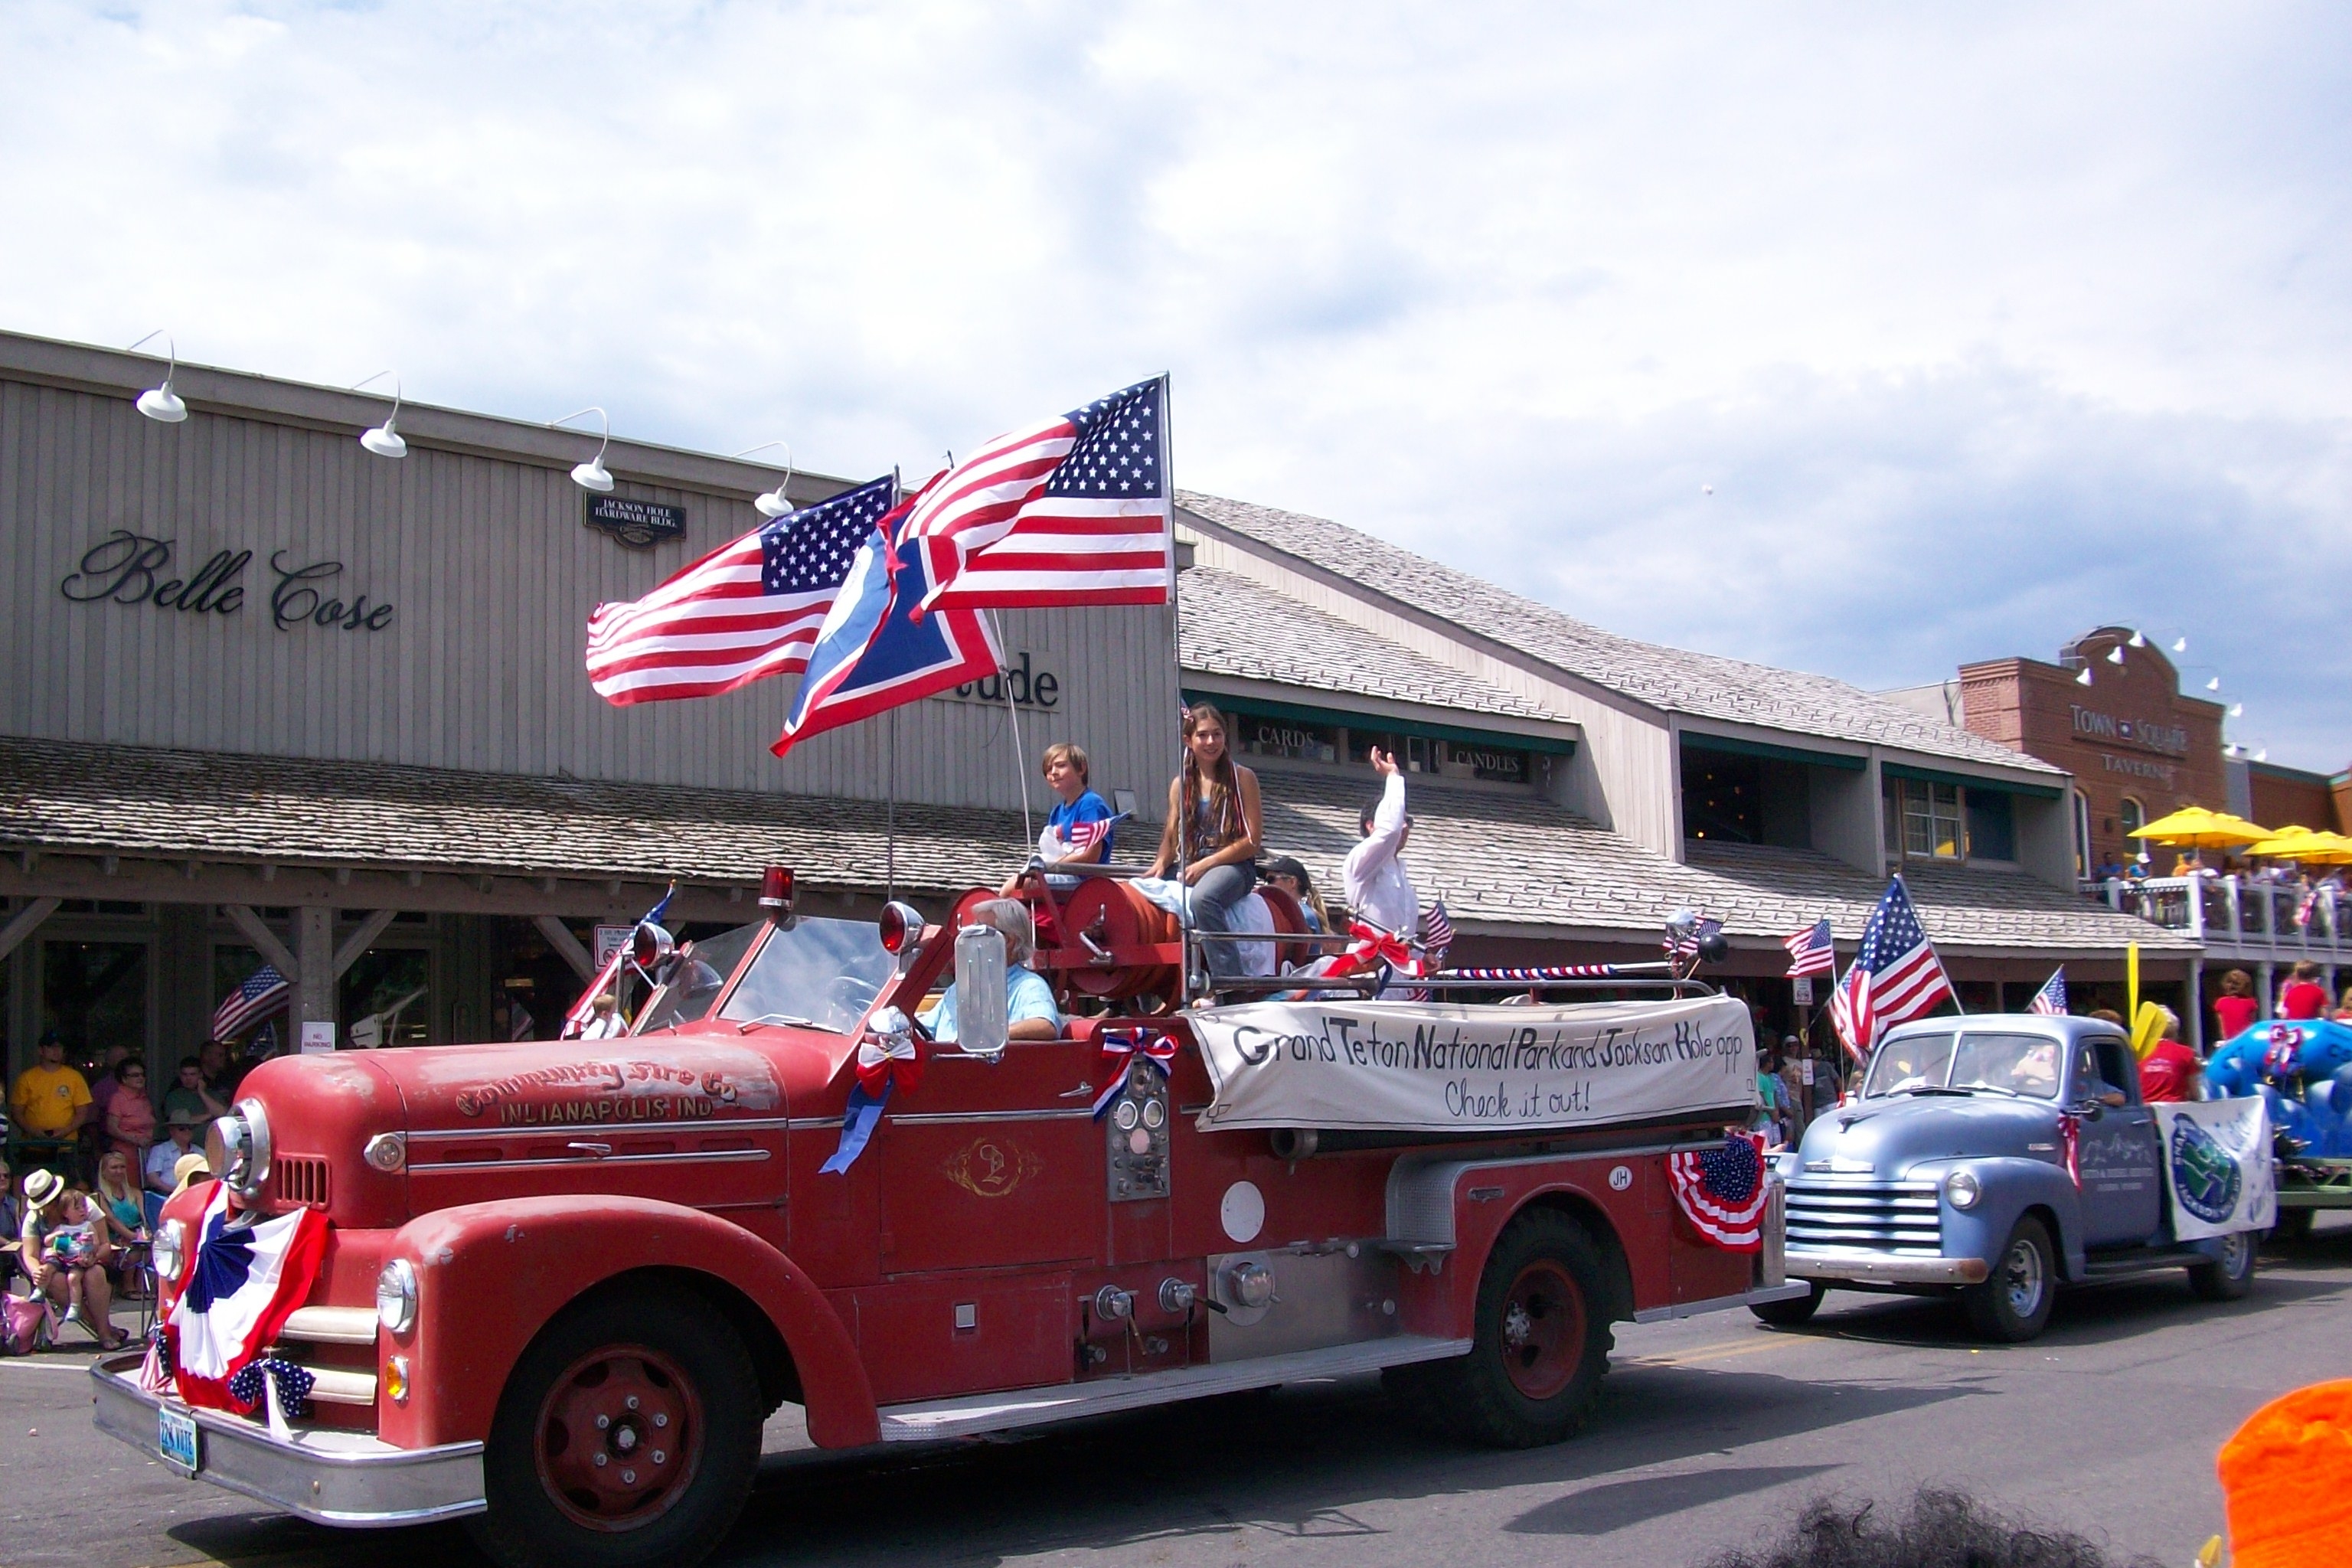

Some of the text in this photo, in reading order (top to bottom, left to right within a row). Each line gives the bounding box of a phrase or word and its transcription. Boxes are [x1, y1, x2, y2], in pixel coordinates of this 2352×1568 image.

[595, 507, 648, 524] HARDWARE
[603, 498, 671, 518] JACKSON HOLE
[61, 530, 394, 631] Belle Cose
[2069, 704, 2118, 737] TOWN
[1258, 726, 1315, 749] CARDS
[1456, 750, 1519, 773] CANDLES
[2101, 753, 2166, 779] TAVERN
[1233, 1017, 1743, 1073] Grand Teton National Park and Jackson Hole app
[1446, 1077, 1589, 1119] Check it out!
[1613, 1170, 1628, 1186] JH
